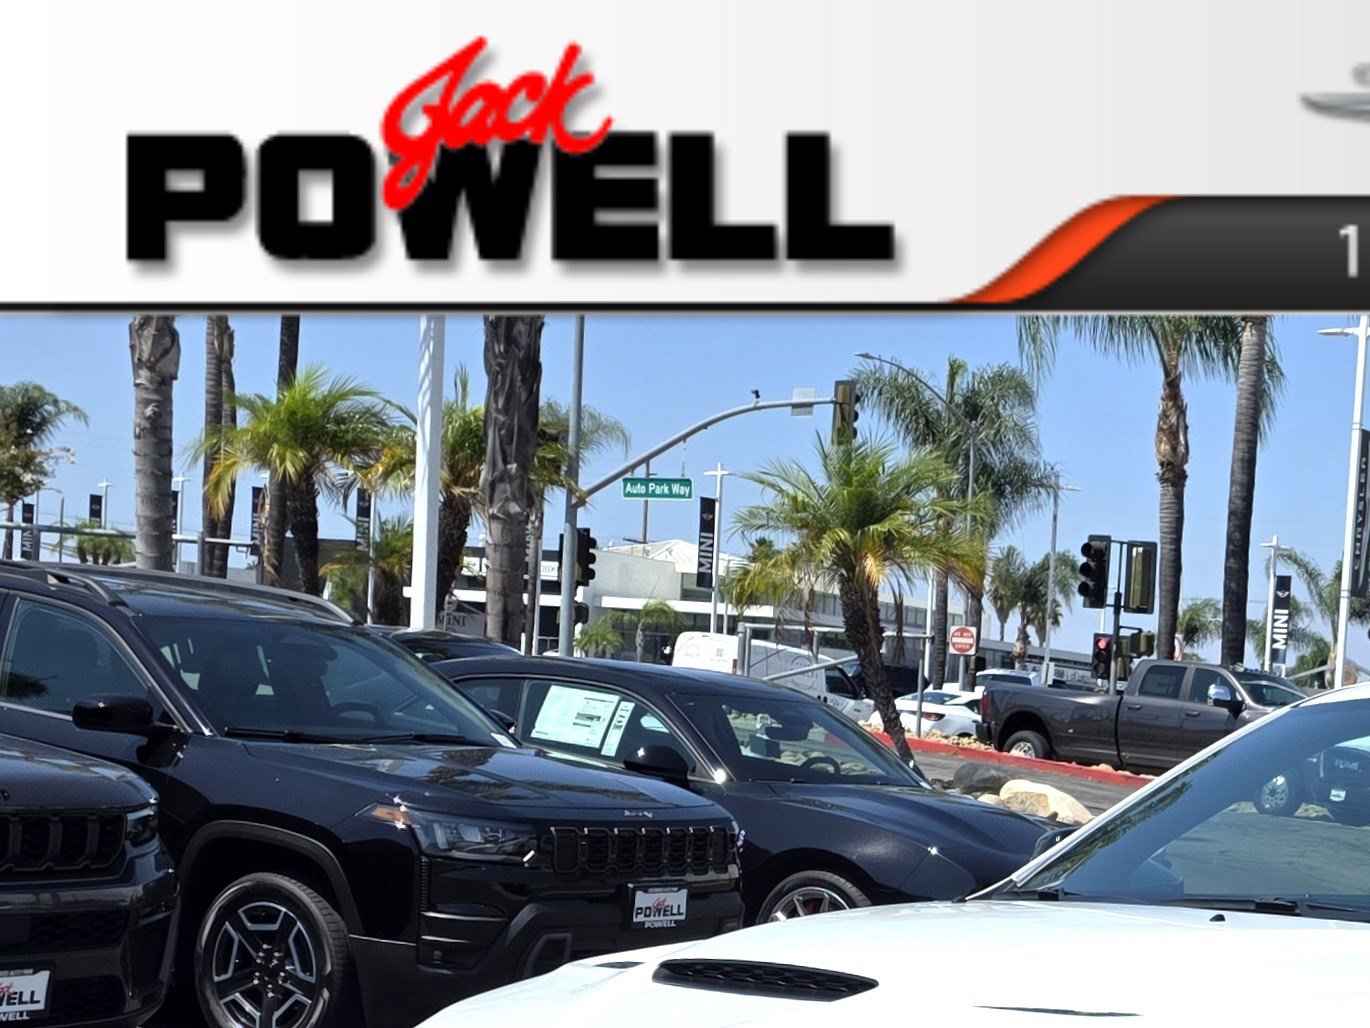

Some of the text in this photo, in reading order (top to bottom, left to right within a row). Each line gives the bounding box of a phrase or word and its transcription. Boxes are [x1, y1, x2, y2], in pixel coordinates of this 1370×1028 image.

[625, 483, 690, 497] Auto Park Way
[1354, 456, 1367, 570] CHRYSLER
[698, 532, 714, 573] MINI
[1272, 608, 1289, 650] MINI
[635, 904, 684, 919] POWELL
[644, 920, 677, 929] POWELL
